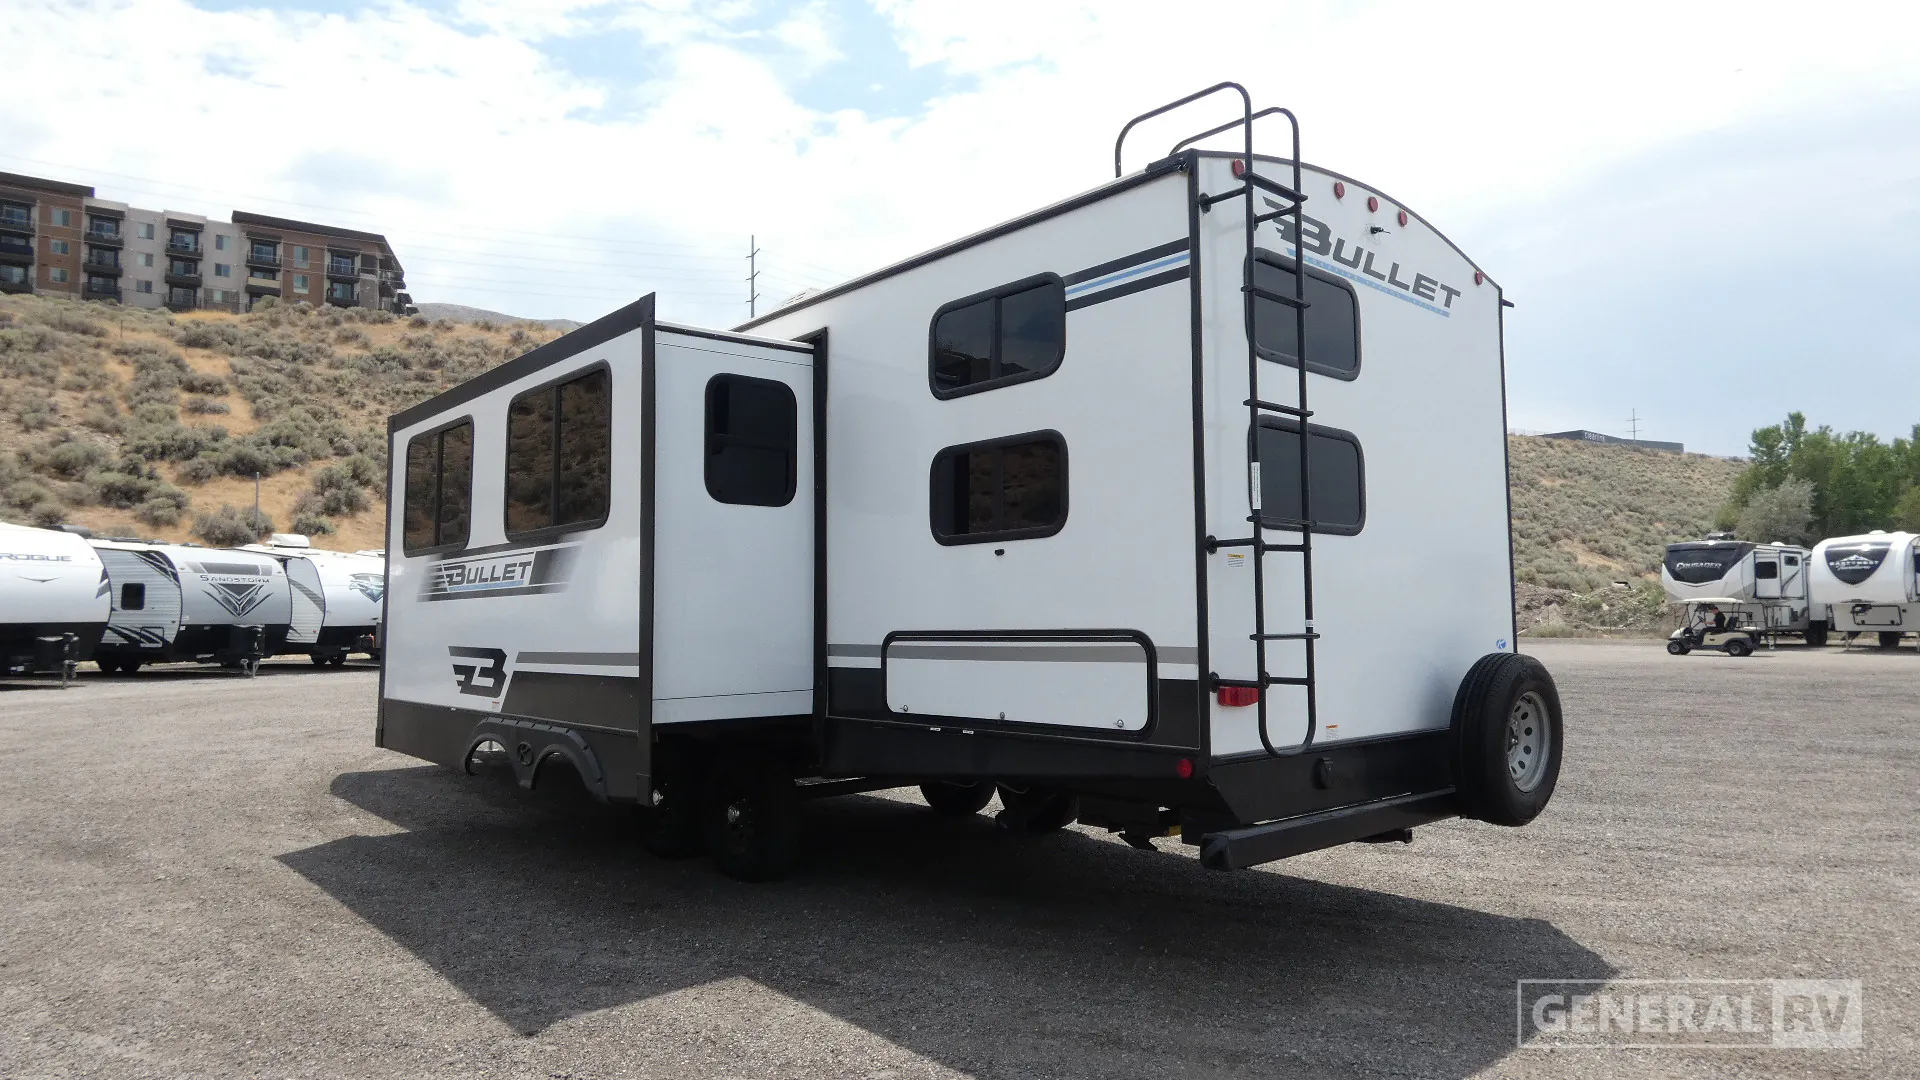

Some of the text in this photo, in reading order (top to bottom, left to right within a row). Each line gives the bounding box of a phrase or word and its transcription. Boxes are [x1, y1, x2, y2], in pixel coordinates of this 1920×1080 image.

[1262, 196, 1461, 308] BULLET
[0, 552, 73, 562] ROGUE
[200, 574, 270, 583] SANDSTORM
[443, 561, 533, 586] BULLET
